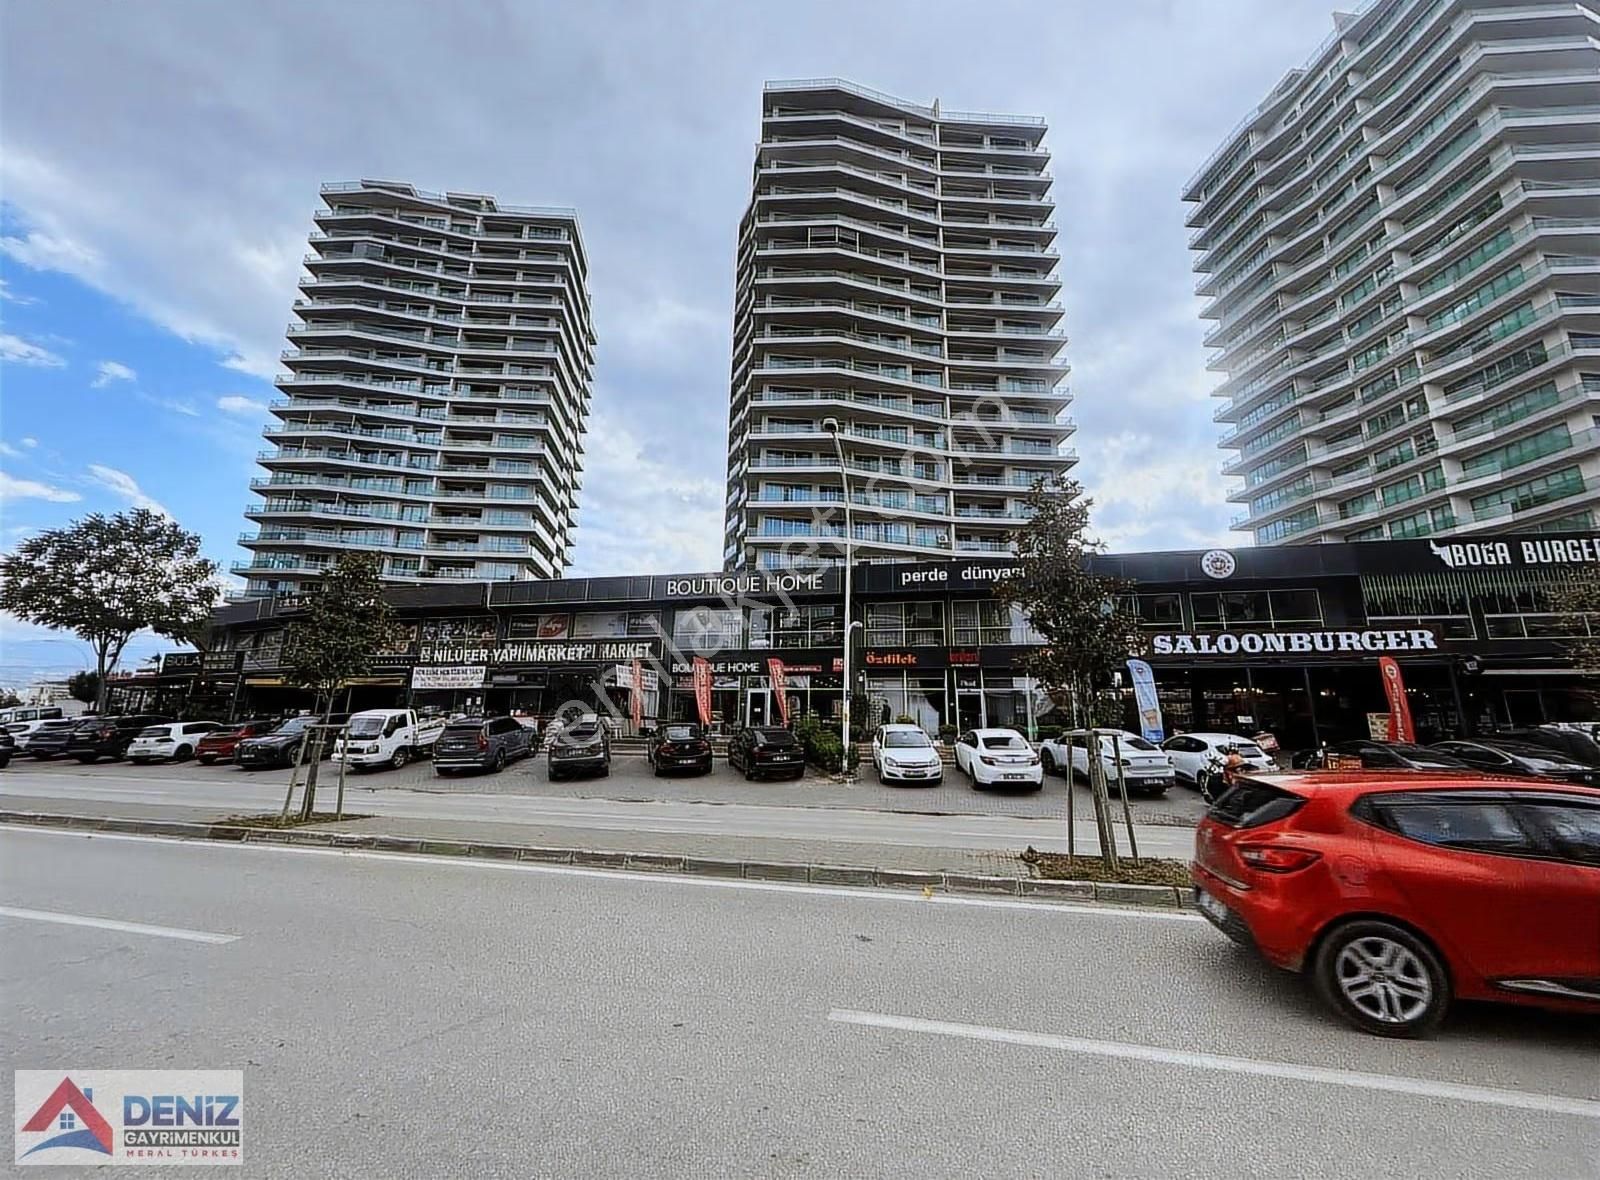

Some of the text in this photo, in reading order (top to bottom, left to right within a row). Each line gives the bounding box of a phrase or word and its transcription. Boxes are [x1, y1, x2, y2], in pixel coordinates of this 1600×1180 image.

[666, 573, 824, 596] BOUTIQUE HOME
[902, 568, 948, 586] perde
[1153, 630, 1438, 654] SALOONBURGER
[672, 662, 761, 674] BOUQUE HOME
